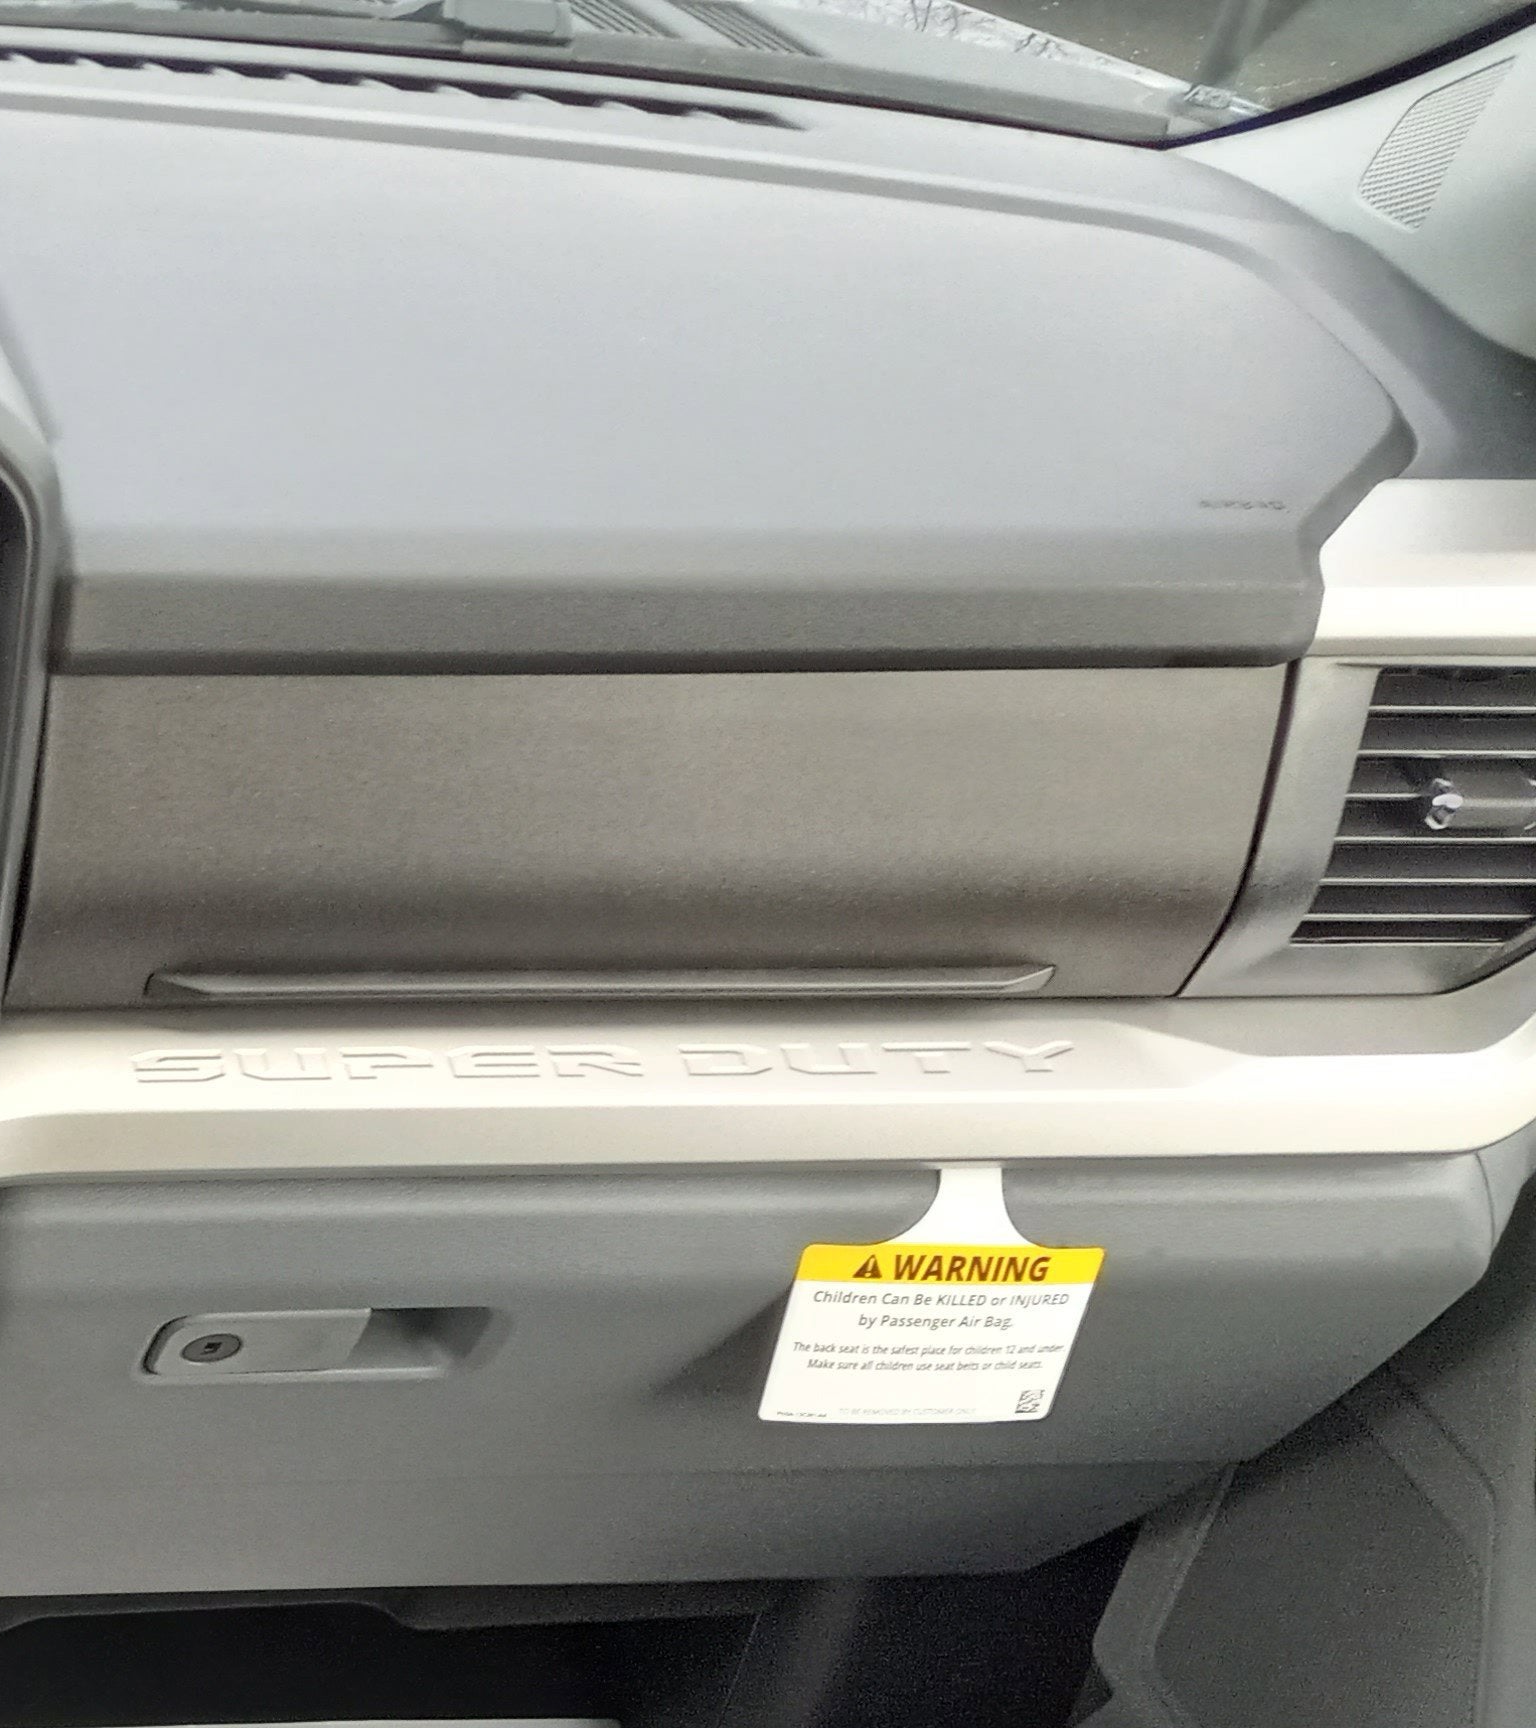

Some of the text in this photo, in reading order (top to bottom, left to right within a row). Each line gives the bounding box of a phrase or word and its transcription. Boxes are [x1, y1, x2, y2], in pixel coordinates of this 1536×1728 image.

[129, 1037, 1075, 1084] SUPER DUTY
[894, 1254, 1051, 1282] WARNING
[813, 1290, 1070, 1309] Children Can Be KILLED or INJURED
[858, 1314, 877, 1329] by
[880, 1315, 955, 1331] Passenger
[958, 1316, 981, 1328] Air
[793, 1341, 810, 1352] The
[813, 1343, 836, 1353] back
[838, 1345, 860, 1354] seat
[861, 1344, 870, 1354] is
[872, 1345, 888, 1355] the
[891, 1345, 920, 1355] safest
[921, 1345, 946, 1357] place
[948, 1345, 963, 1355] for
[964, 1345, 1002, 1355] children
[1017, 1345, 1036, 1354] and
[807, 1359, 835, 1369] Make
[837, 1361, 859, 1370] sure
[860, 1360, 873, 1371] all
[875, 1360, 914, 1371] children
[916, 1362, 932, 1371] use
[934, 1361, 955, 1371] seat
[982, 1362, 992, 1370] or
[994, 1360, 1018, 1370] child
